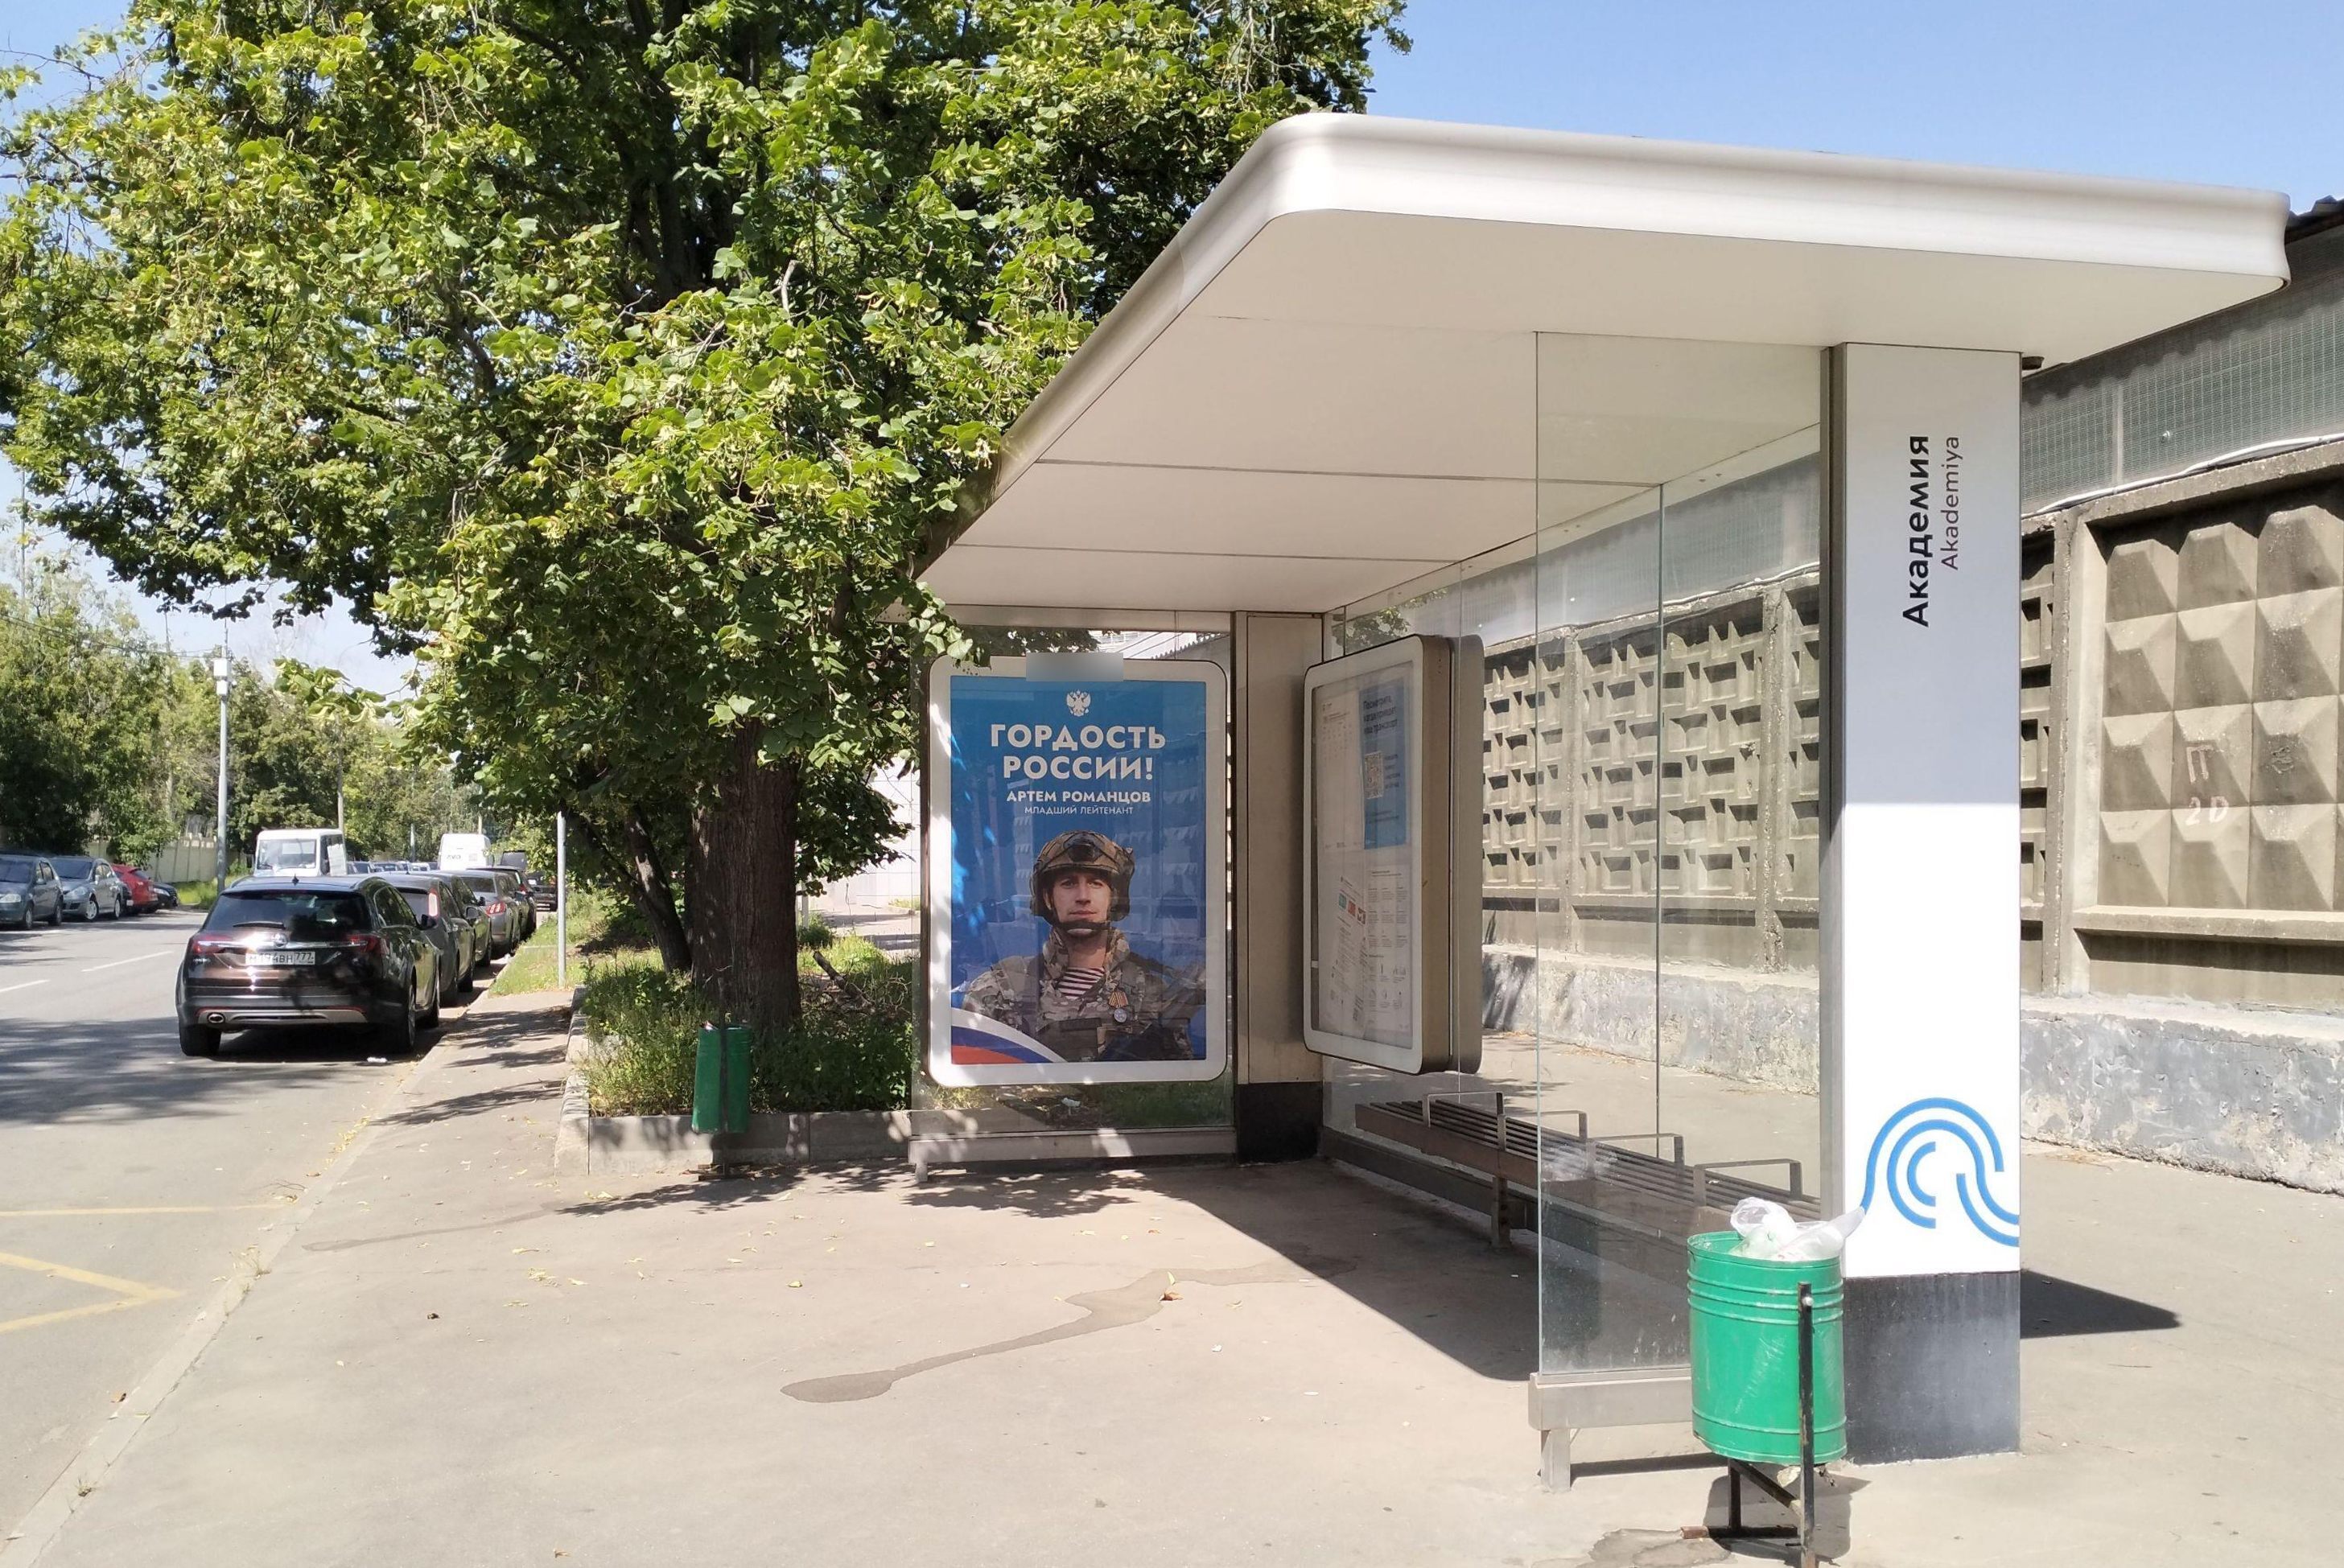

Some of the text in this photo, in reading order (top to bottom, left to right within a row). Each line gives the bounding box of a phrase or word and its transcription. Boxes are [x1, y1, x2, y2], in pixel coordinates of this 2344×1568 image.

[1940, 437, 1963, 570] Akademiya
[1902, 436, 1933, 628] Академия
[991, 724, 1166, 751] ГОРДОСТЬ
[1003, 755, 1153, 780] РОССИИ!
[1007, 791, 1151, 804] АРТЕМ РОМАНЦОВ
[1024, 805, 1133, 815] МЛАДШИЙ ЛЕЙТЕНАНТ
